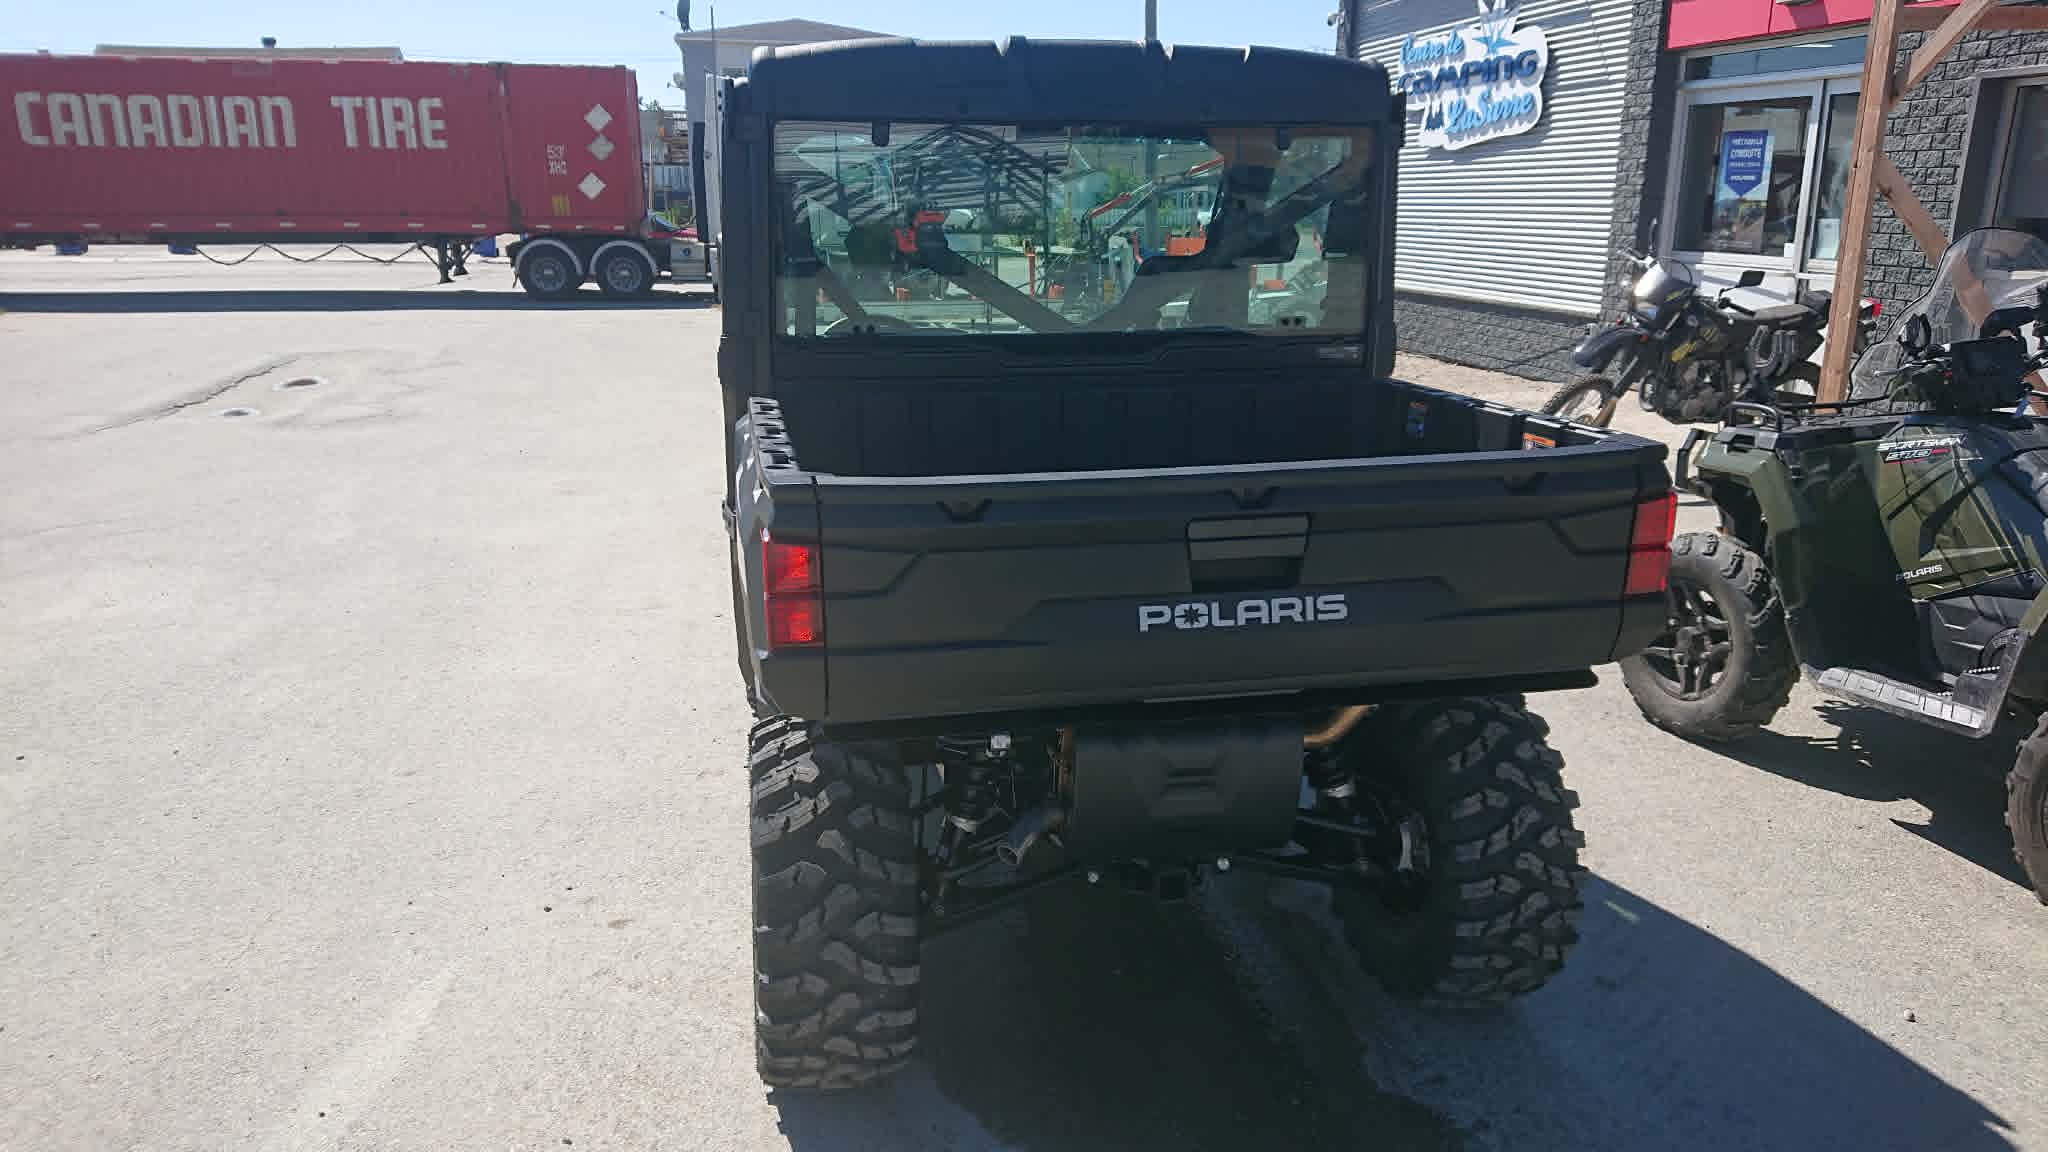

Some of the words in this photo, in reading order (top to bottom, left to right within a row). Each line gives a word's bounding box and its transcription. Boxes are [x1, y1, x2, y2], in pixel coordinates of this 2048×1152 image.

[13, 91, 297, 149] CANADIAN
[330, 96, 448, 149] TIRE
[1138, 593, 1348, 632] POLARIS
